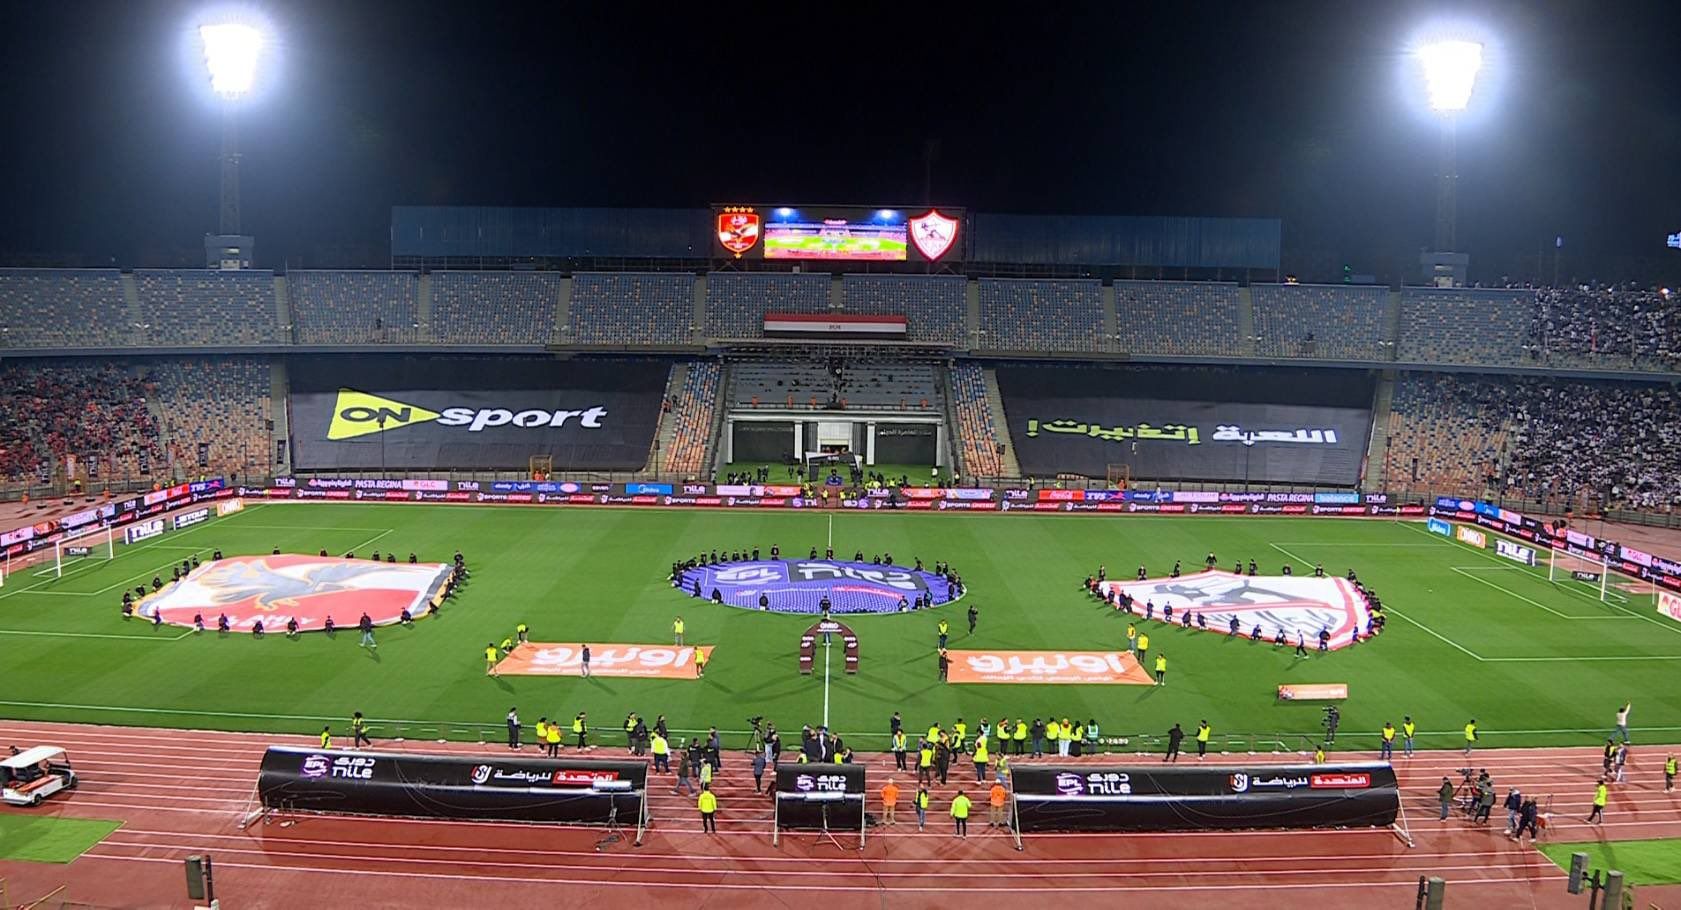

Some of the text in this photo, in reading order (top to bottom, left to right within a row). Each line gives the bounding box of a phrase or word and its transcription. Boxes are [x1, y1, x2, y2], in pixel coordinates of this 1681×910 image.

[340, 406, 607, 432] ON sport
[355, 480, 377, 489] PASTA
[378, 480, 402, 489] REGINA
[1267, 494, 1288, 502] PASTA
[1289, 495, 1314, 503] REGINA
[304, 761, 327, 769] EPL
[1057, 778, 1081, 787] EPL
